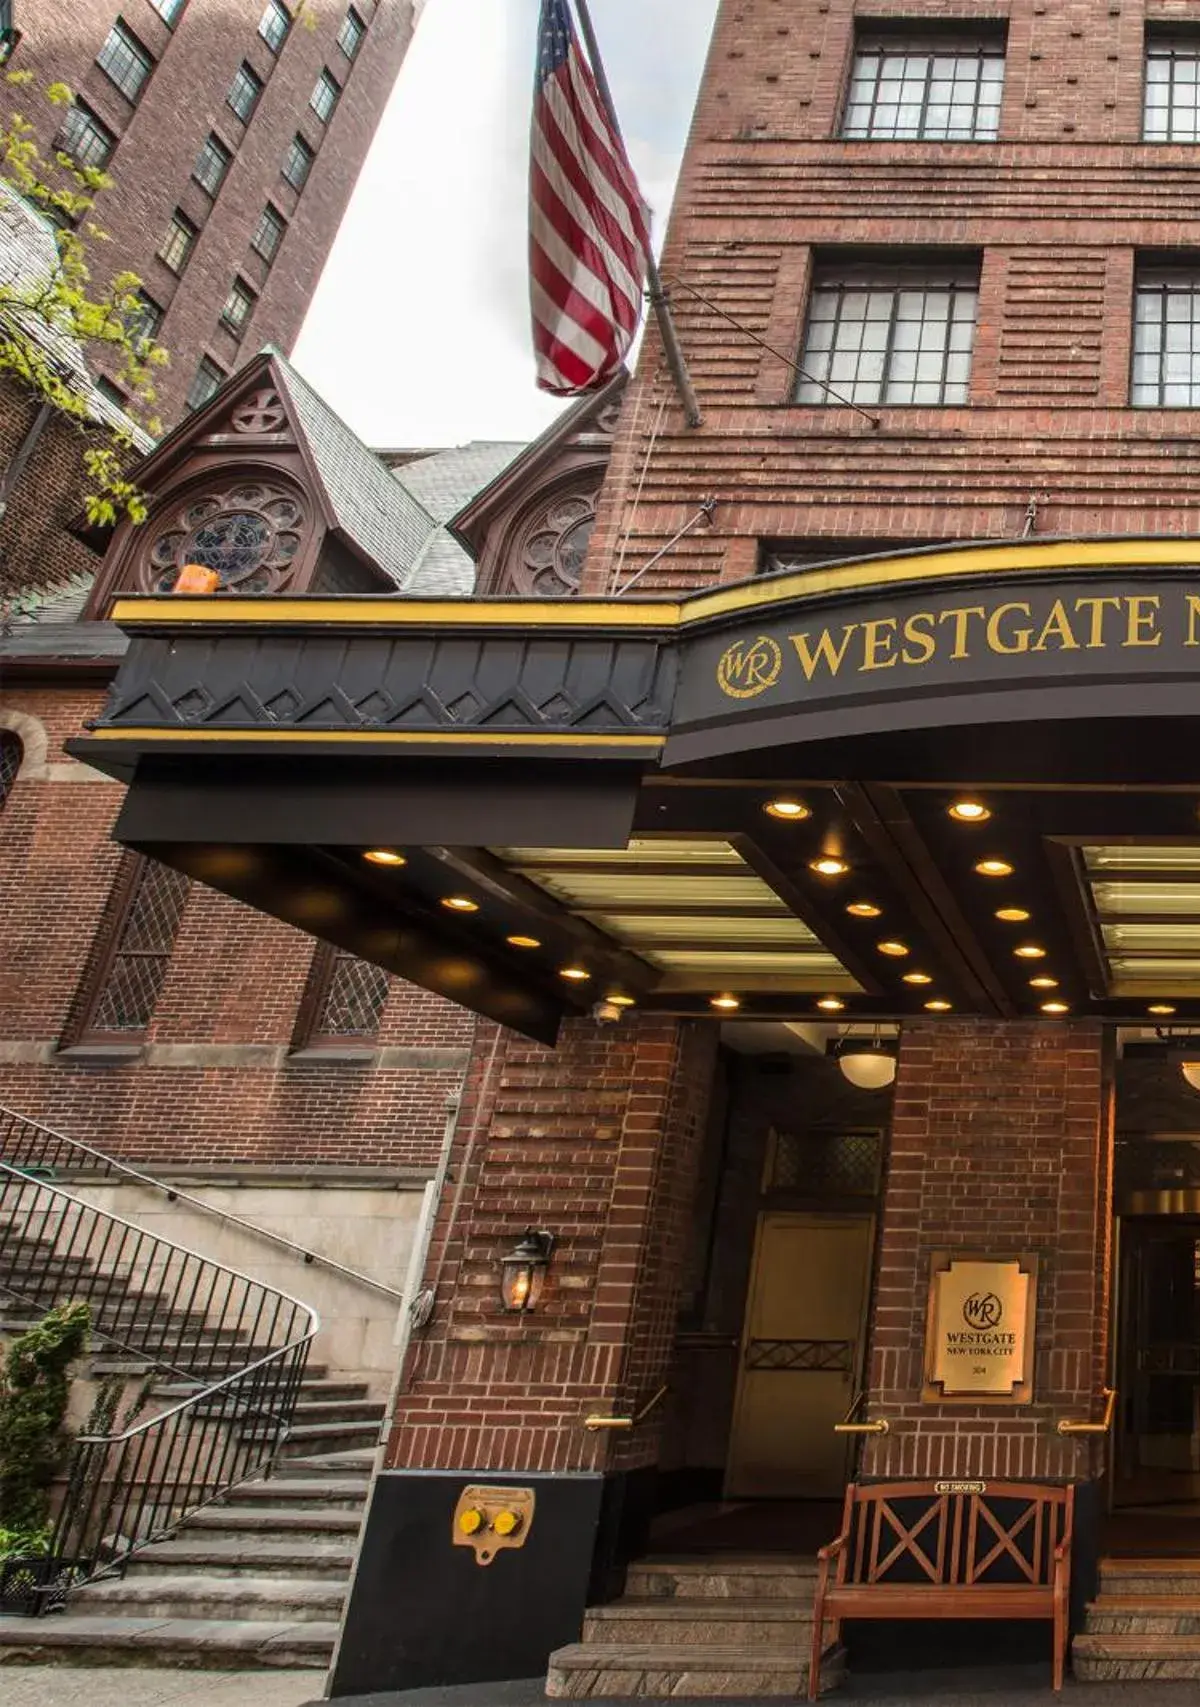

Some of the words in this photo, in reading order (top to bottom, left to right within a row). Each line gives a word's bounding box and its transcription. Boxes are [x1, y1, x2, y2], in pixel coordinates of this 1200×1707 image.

[788, 596, 1162, 682] WESTGATE
[946, 1332, 1016, 1345] WESTGATE
[946, 1347, 965, 1355] NEW
[968, 1347, 992, 1355] YORK
[993, 1347, 1014, 1355] CITY
